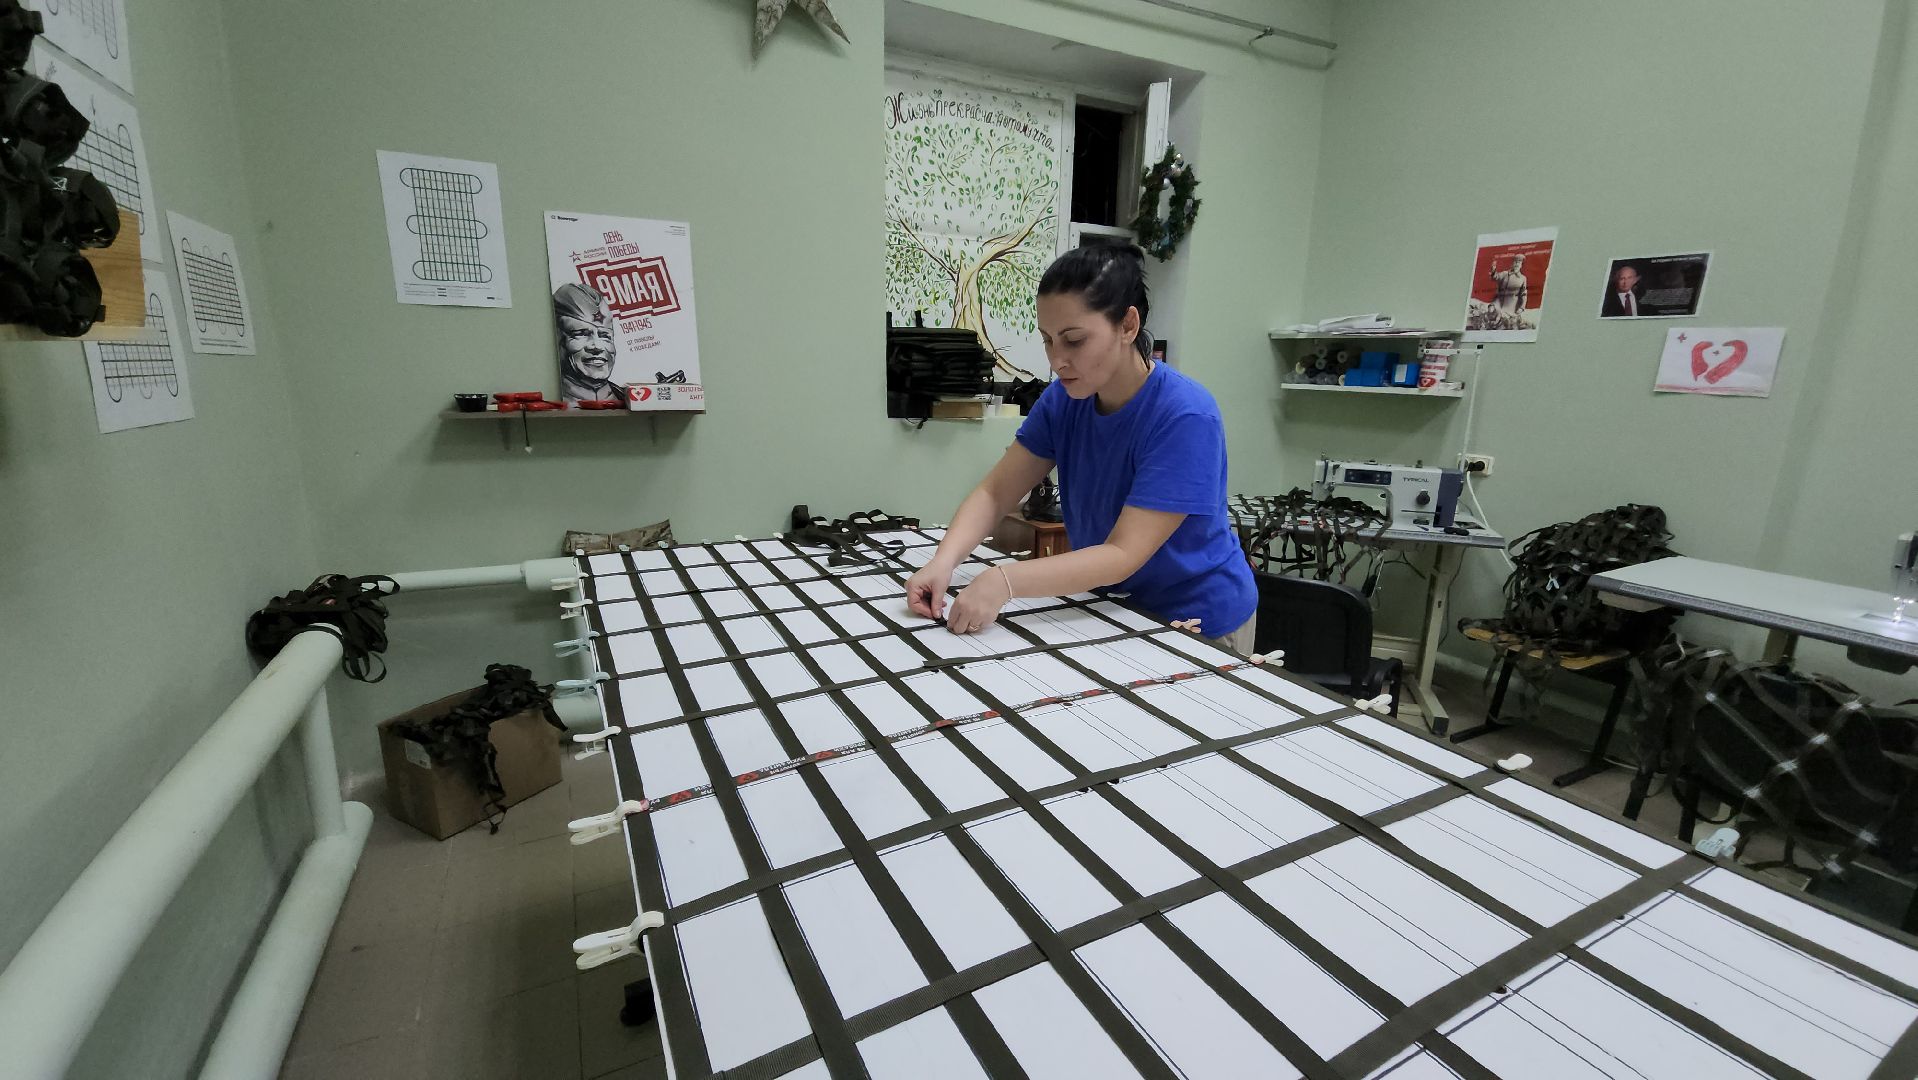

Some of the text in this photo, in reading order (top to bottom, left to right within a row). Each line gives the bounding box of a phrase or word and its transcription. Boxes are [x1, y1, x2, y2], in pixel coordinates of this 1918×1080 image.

[884, 91, 936, 130] Жизнь
[603, 230, 624, 245] ДЕНЬ
[607, 242, 640, 259] ПОБЕДЫ
[619, 317, 653, 334] 1941-1945
